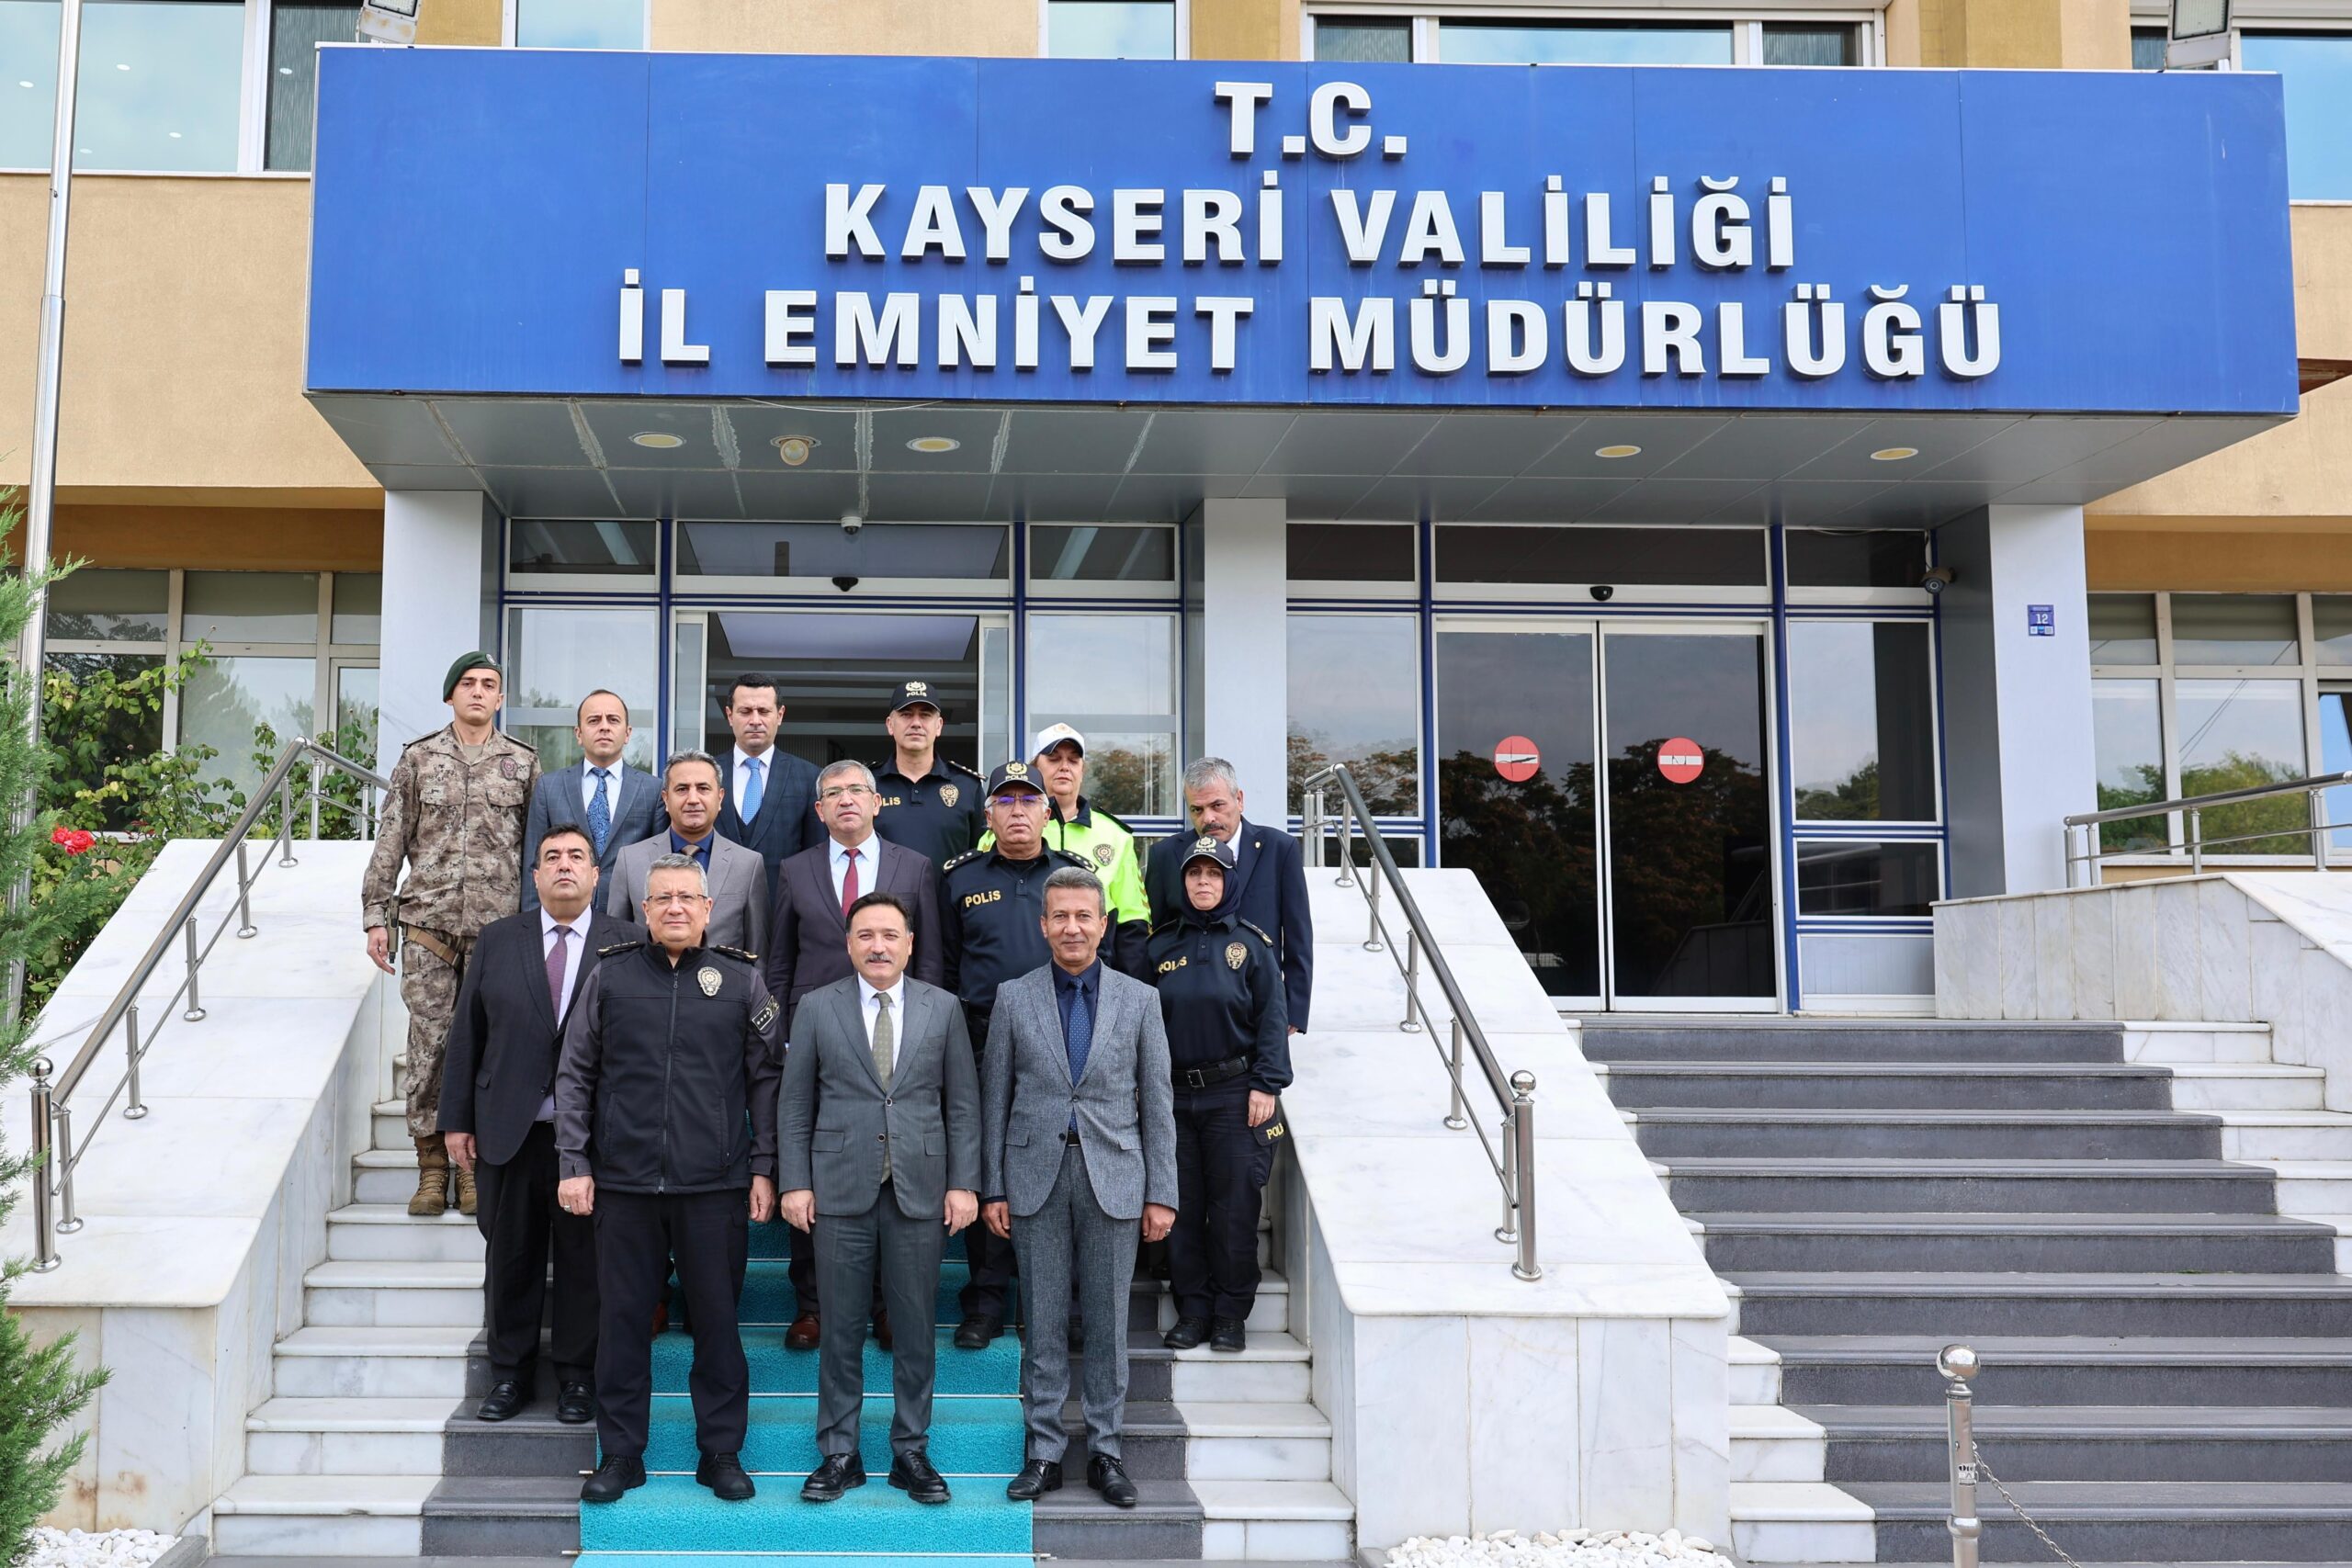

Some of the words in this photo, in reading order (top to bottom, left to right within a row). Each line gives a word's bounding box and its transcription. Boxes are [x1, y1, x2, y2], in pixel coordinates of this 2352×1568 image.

[1215, 81, 1408, 155] T.C.
[825, 170, 1283, 261] KAYSERİ
[1330, 175, 1793, 266] VALİLİĞİ
[619, 268, 710, 361] İL
[764, 276, 1254, 368] EMNİYET
[1310, 278, 2000, 377] MÜDÜRLÜĞÜ
[2036, 614, 2049, 625] 12
[965, 890, 1001, 908] POLİS
